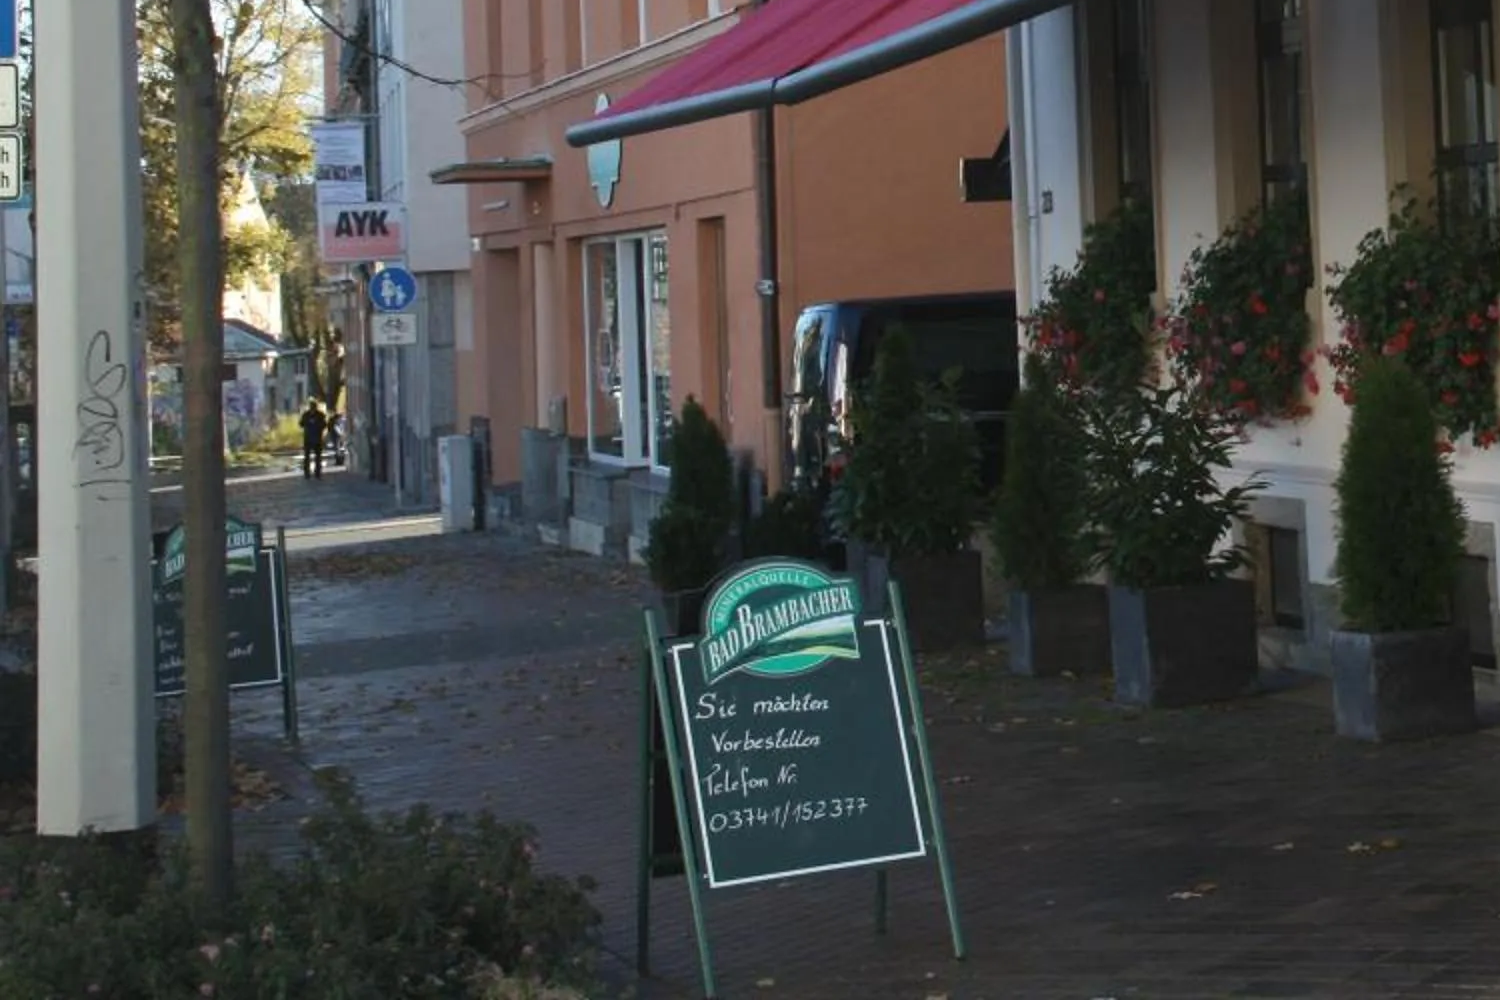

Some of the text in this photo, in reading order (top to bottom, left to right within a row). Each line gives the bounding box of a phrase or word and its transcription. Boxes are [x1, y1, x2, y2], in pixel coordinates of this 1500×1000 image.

[335, 209, 390, 238] AYK
[708, 586, 854, 672] BAD BRAMBACHER
[695, 692, 737, 719] Sie
[702, 763, 769, 797] Telefon
